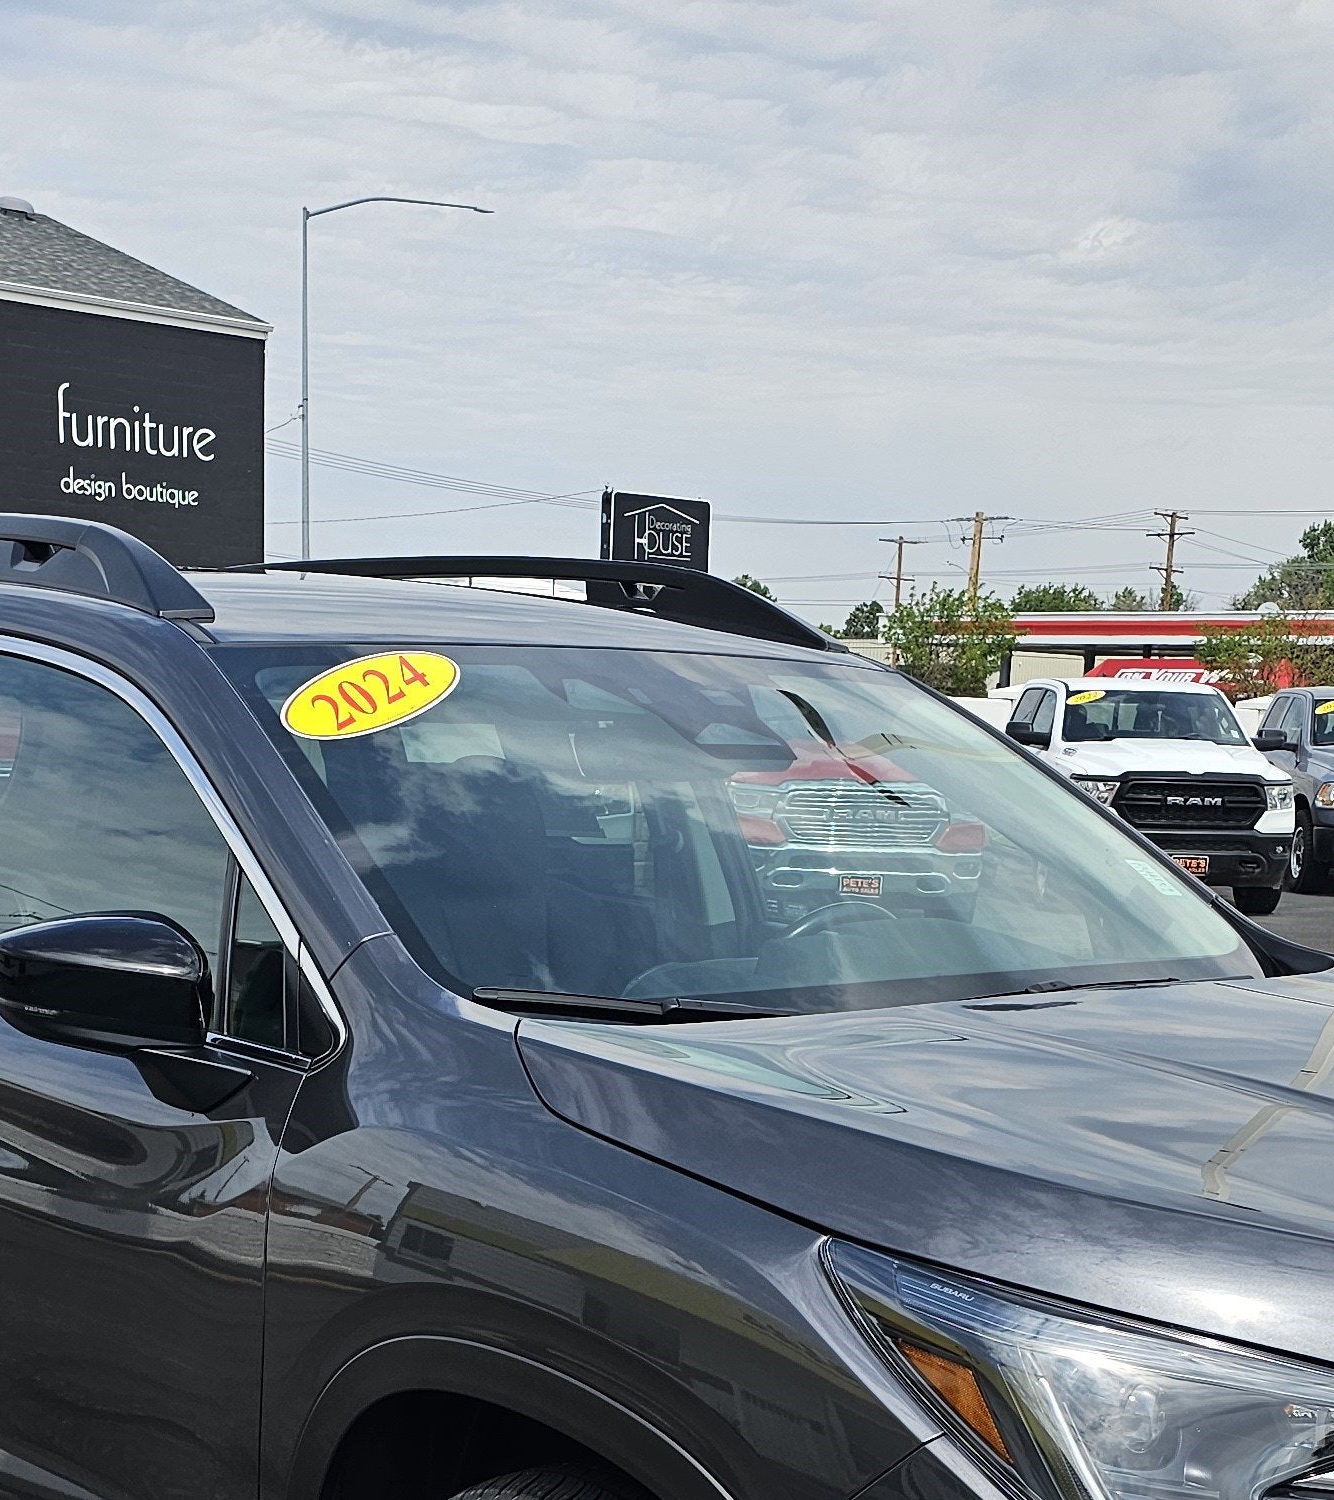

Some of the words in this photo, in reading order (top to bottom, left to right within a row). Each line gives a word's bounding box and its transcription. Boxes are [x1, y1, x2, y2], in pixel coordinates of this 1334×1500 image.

[57, 382, 217, 462] furniture
[60, 466, 116, 501] design
[122, 472, 199, 508] boutique
[649, 515, 692, 535] Decorating
[634, 511, 692, 560] HOUSE
[310, 655, 431, 732] 2024
[1166, 796, 1223, 806] RAM
[833, 808, 896, 820] RAM
[842, 878, 879, 888] PETE'S
[929, 1283, 975, 1302] SUBARU
